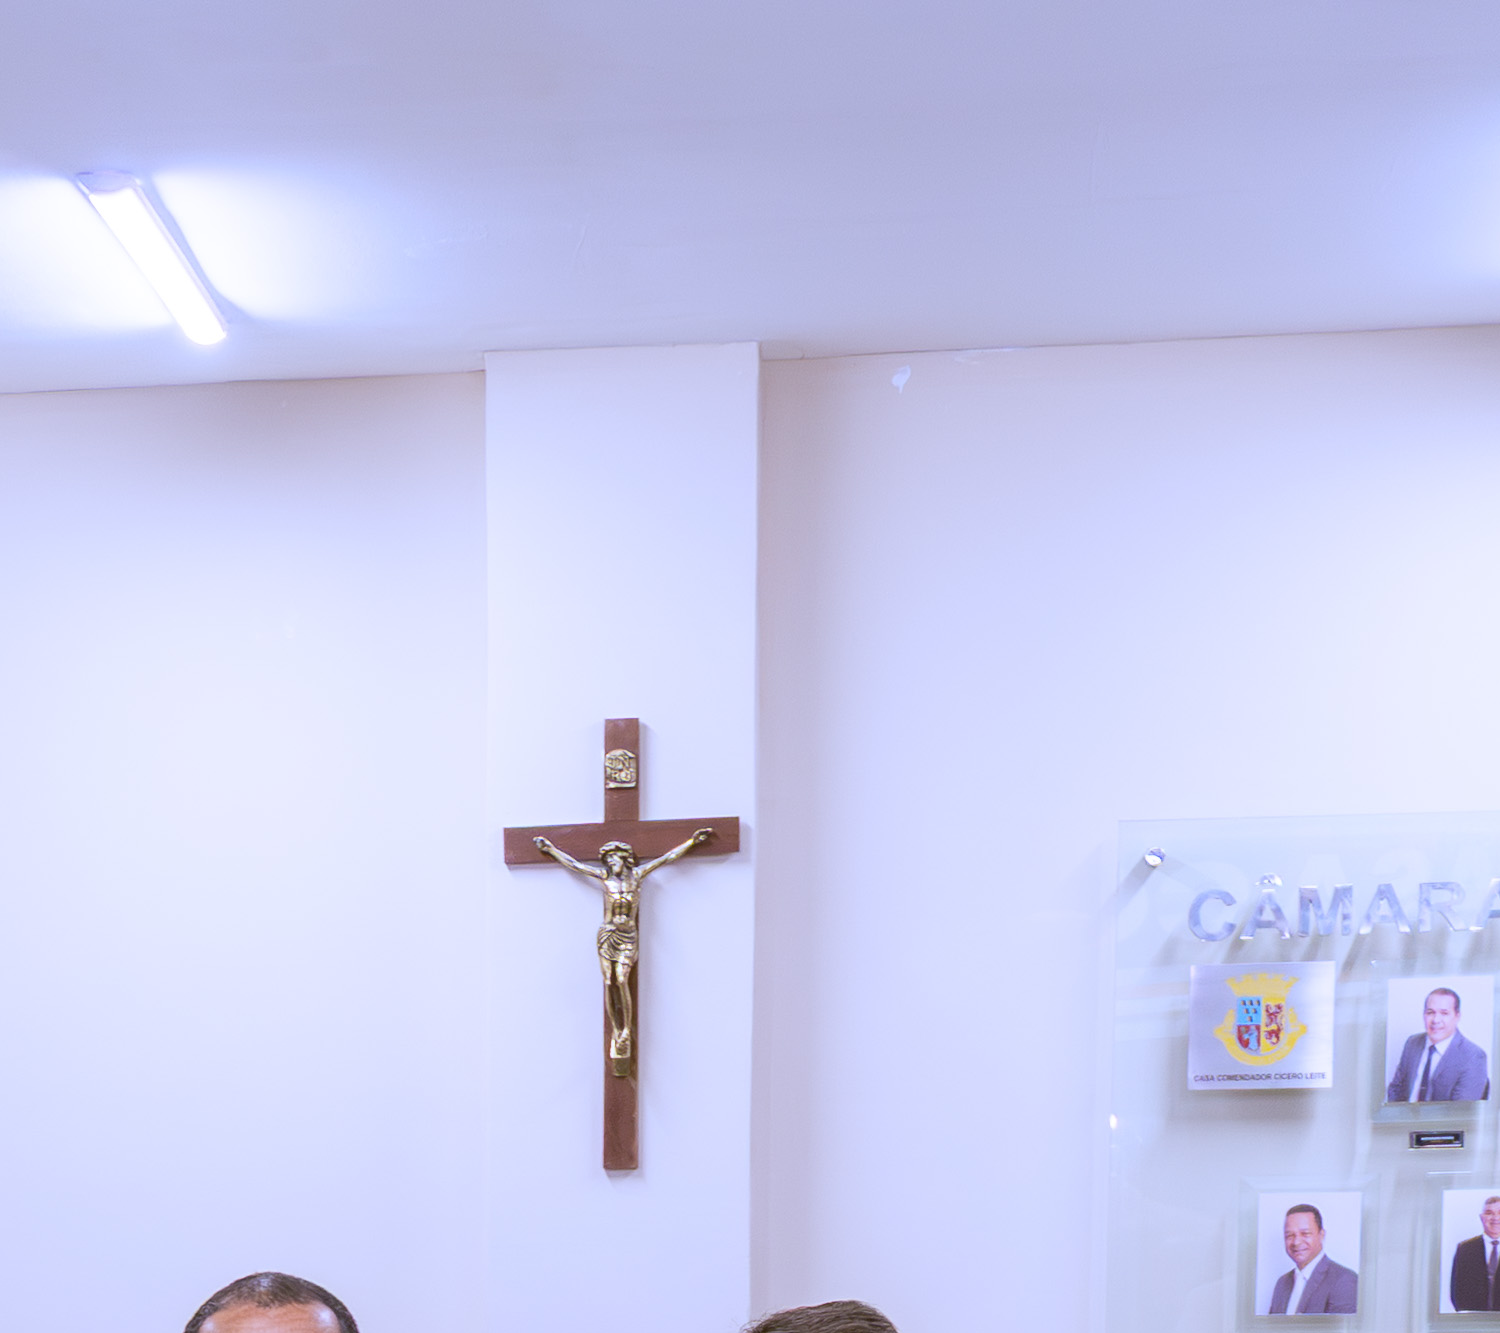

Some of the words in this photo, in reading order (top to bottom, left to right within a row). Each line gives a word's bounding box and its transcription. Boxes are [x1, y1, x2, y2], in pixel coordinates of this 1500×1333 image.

[1193, 1074, 1215, 1083] CASA
[1216, 1073, 1272, 1082] COMENDADOR
[1305, 1071, 1327, 1080] LEITE
